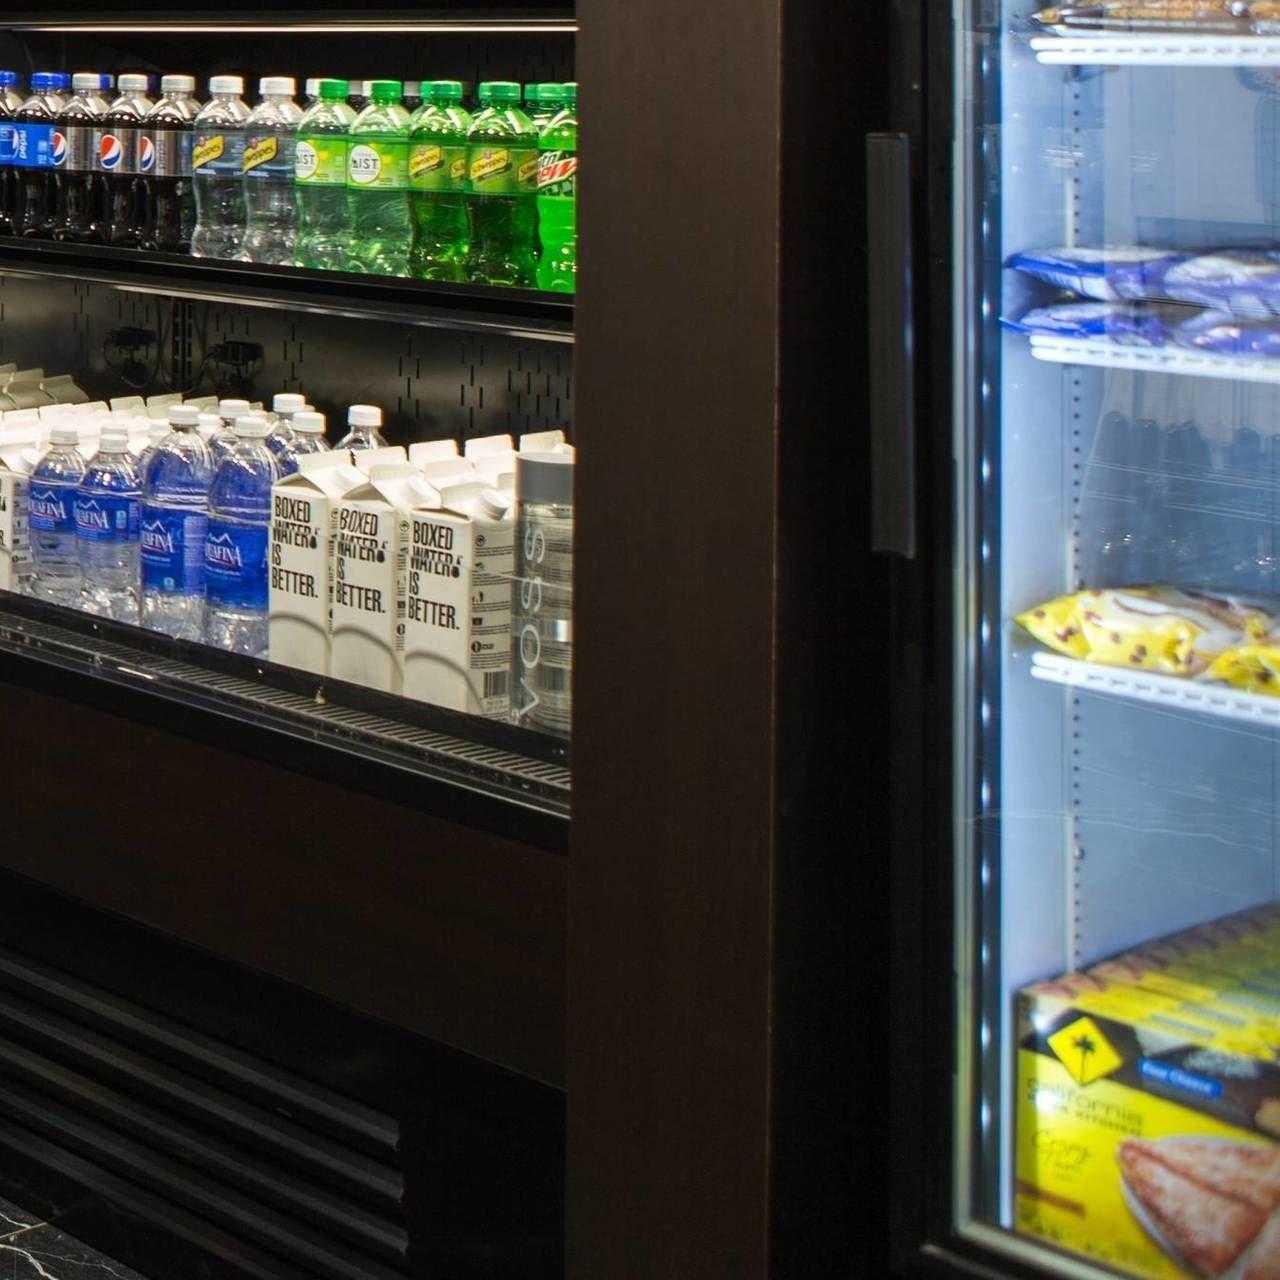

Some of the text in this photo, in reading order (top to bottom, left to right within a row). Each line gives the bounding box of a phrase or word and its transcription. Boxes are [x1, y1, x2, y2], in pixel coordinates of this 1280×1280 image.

[274, 495, 311, 523] BOXED
[339, 507, 378, 537] BOXED
[273, 523, 311, 549] WATER
[337, 533, 377, 563] WATER
[412, 520, 453, 551] BOXED
[272, 543, 282, 566] IS
[336, 556, 345, 580] IS
[410, 547, 453, 578] WATER
[271, 569, 319, 599] BETTER.
[335, 583, 386, 614] BETTER.
[408, 571, 420, 596] IS
[407, 596, 461, 631] BETTER.
[518, 526, 546, 716] VOSS
